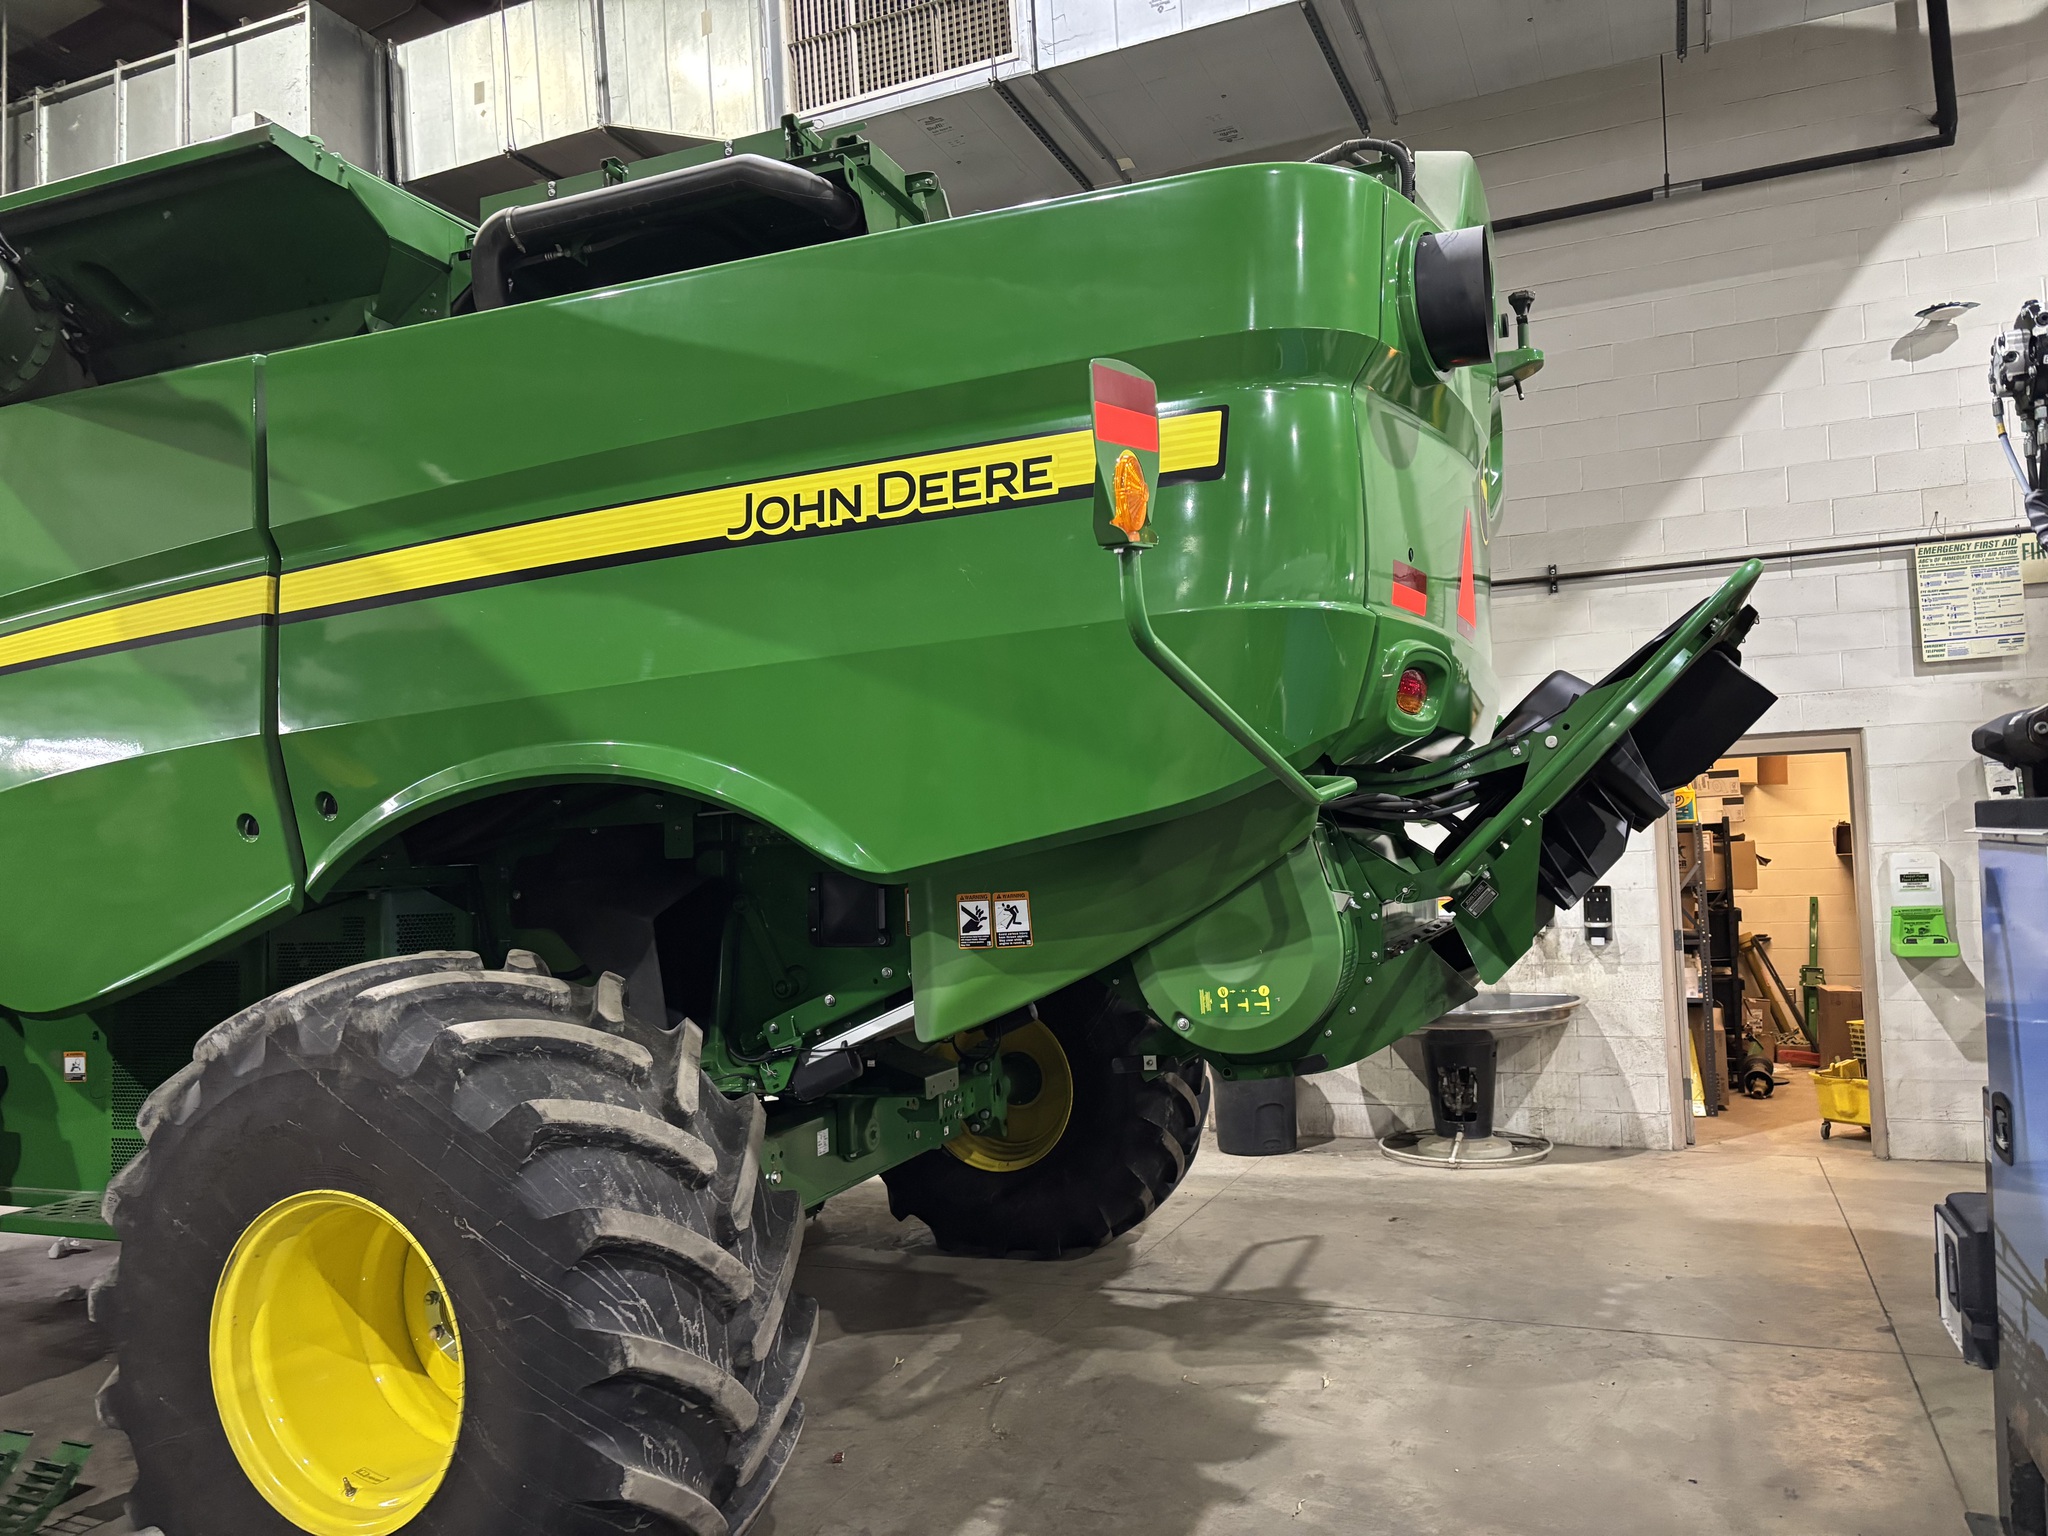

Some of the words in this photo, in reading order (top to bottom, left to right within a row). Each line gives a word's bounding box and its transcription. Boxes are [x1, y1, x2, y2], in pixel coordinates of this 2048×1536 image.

[727, 484, 862, 536] JOHN
[878, 455, 1053, 514] DEERE
[1918, 543, 1973, 555] EMERGENCY
[1974, 540, 2000, 549] FIRST
[2002, 538, 2017, 546] AID
